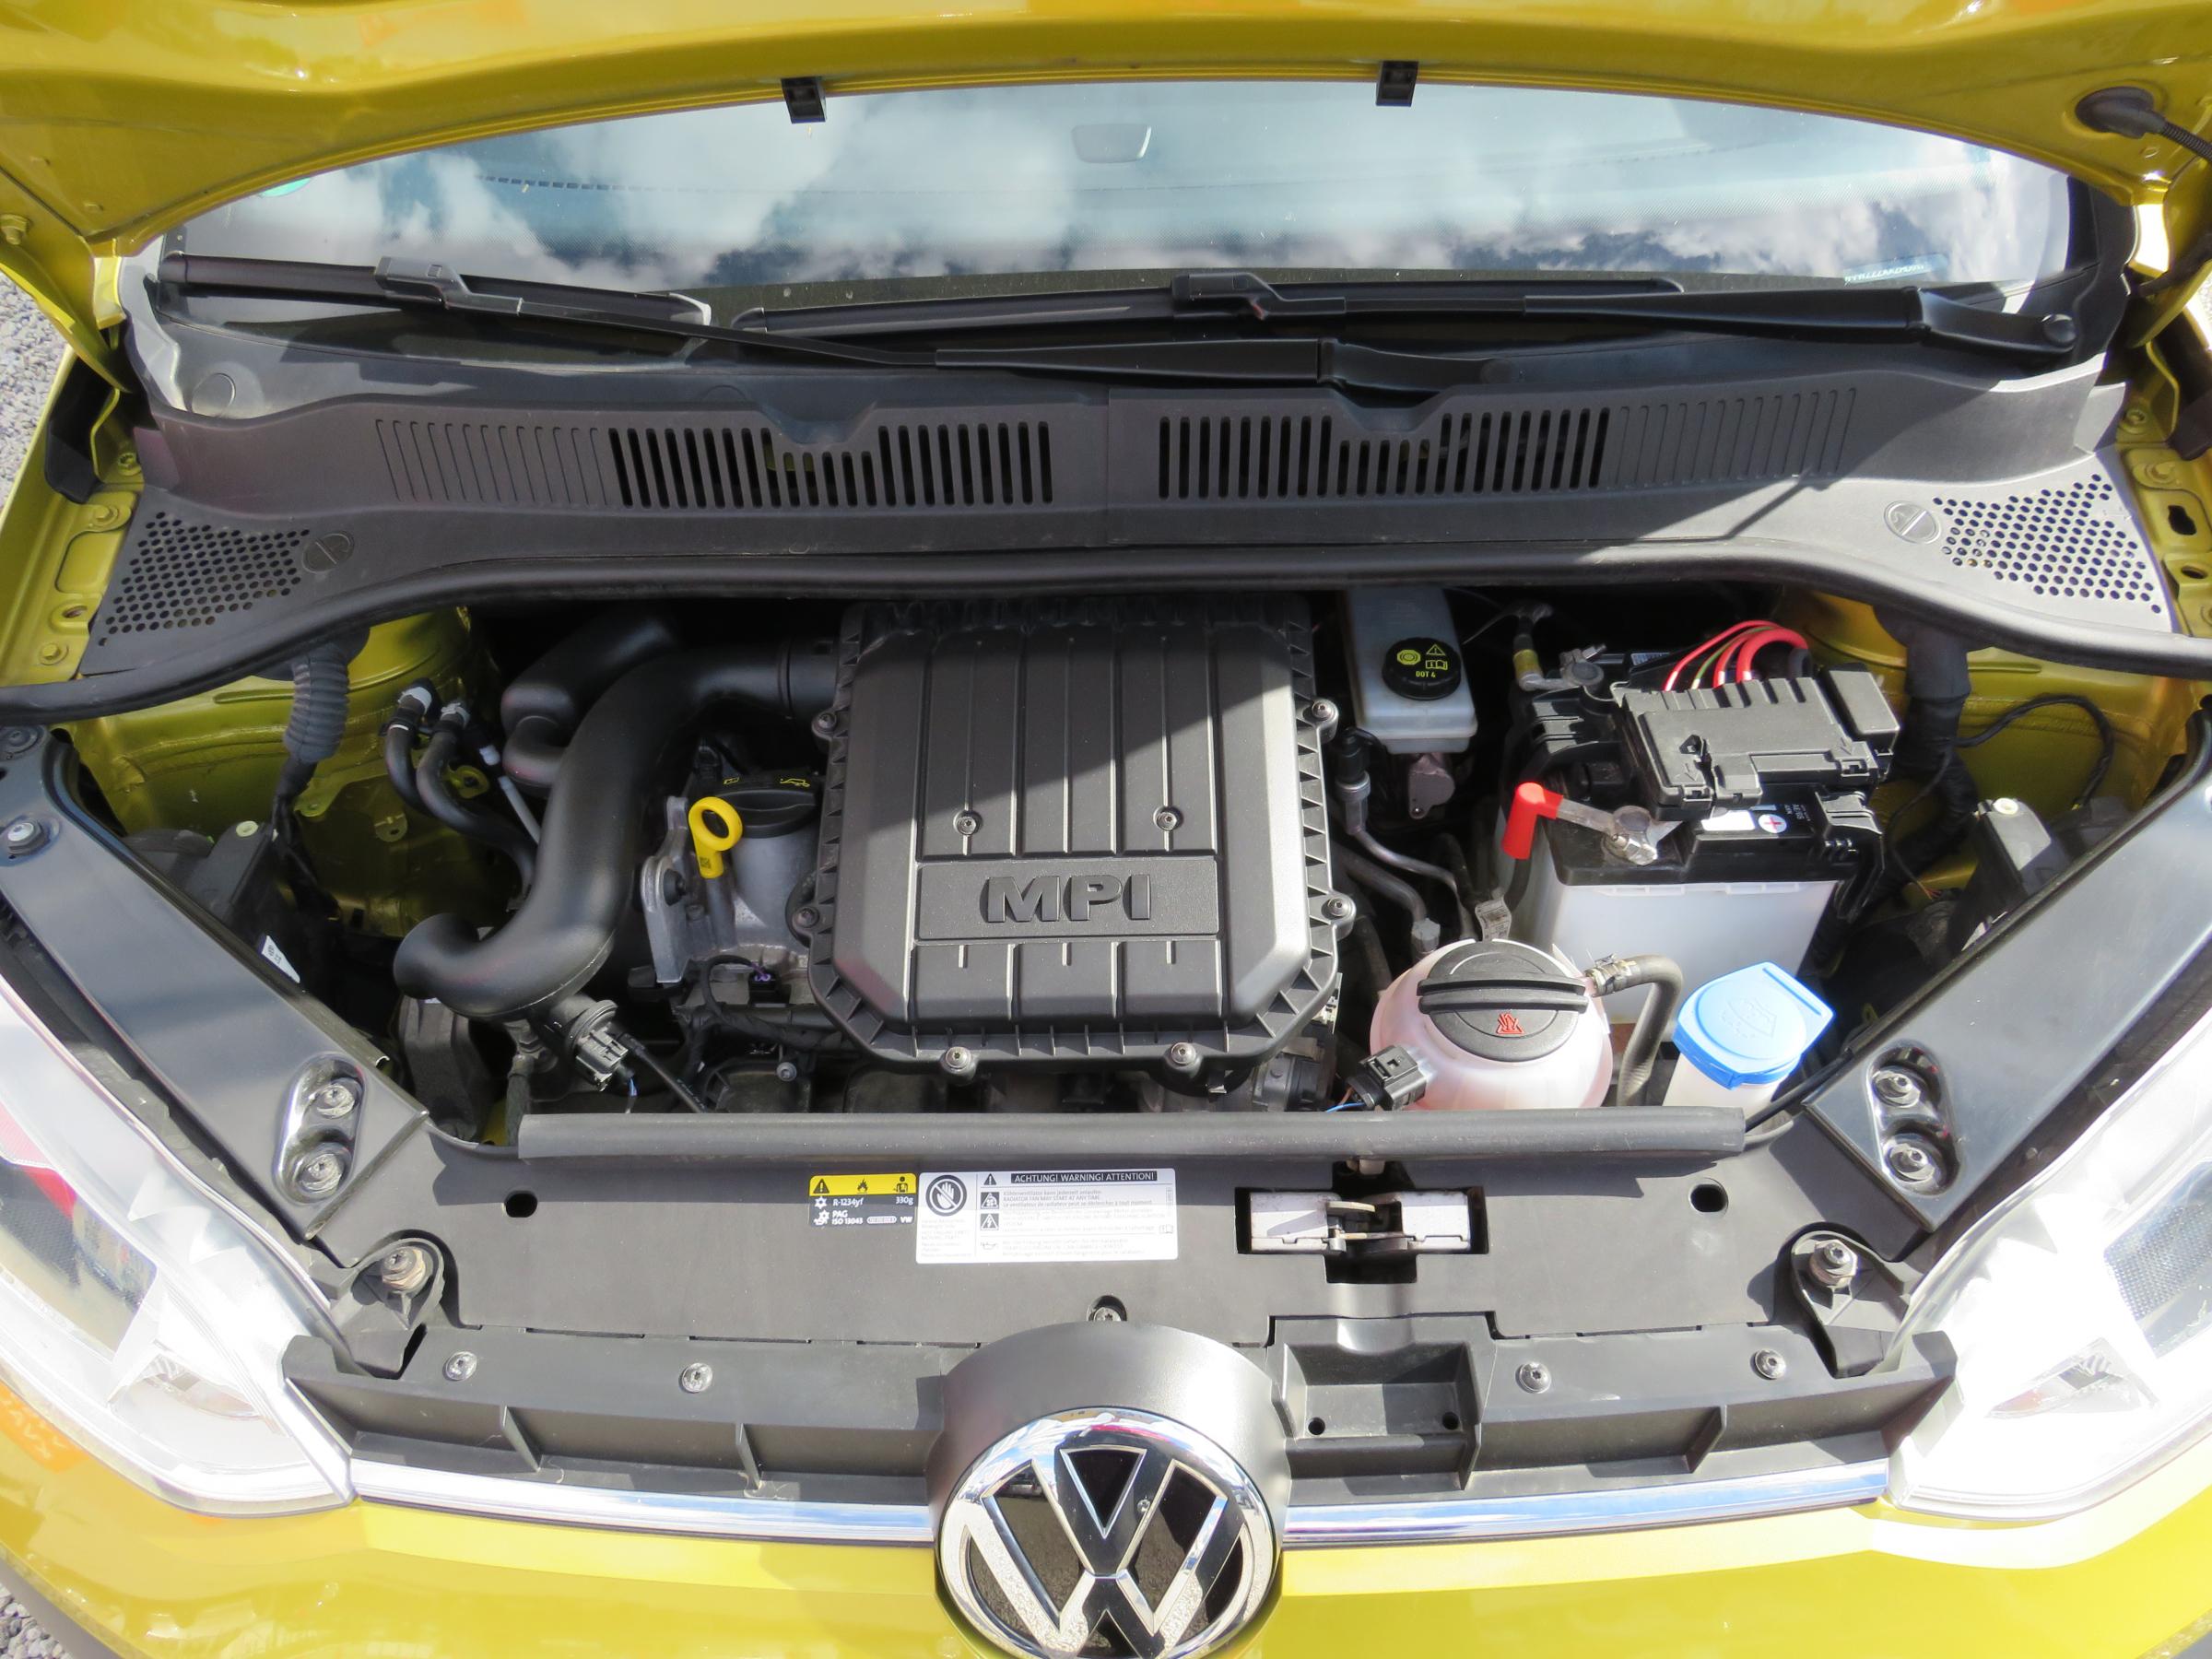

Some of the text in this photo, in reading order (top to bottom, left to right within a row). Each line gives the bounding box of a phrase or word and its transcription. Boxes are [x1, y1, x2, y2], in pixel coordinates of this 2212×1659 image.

[980, 875, 1151, 923] MPI
[1014, 1172, 1154, 1182] ACHTUNG! WARNING! ATTENTION!
[832, 1196, 913, 1207] R-1234yf 330g
[949, 1429, 1265, 1658] VW
